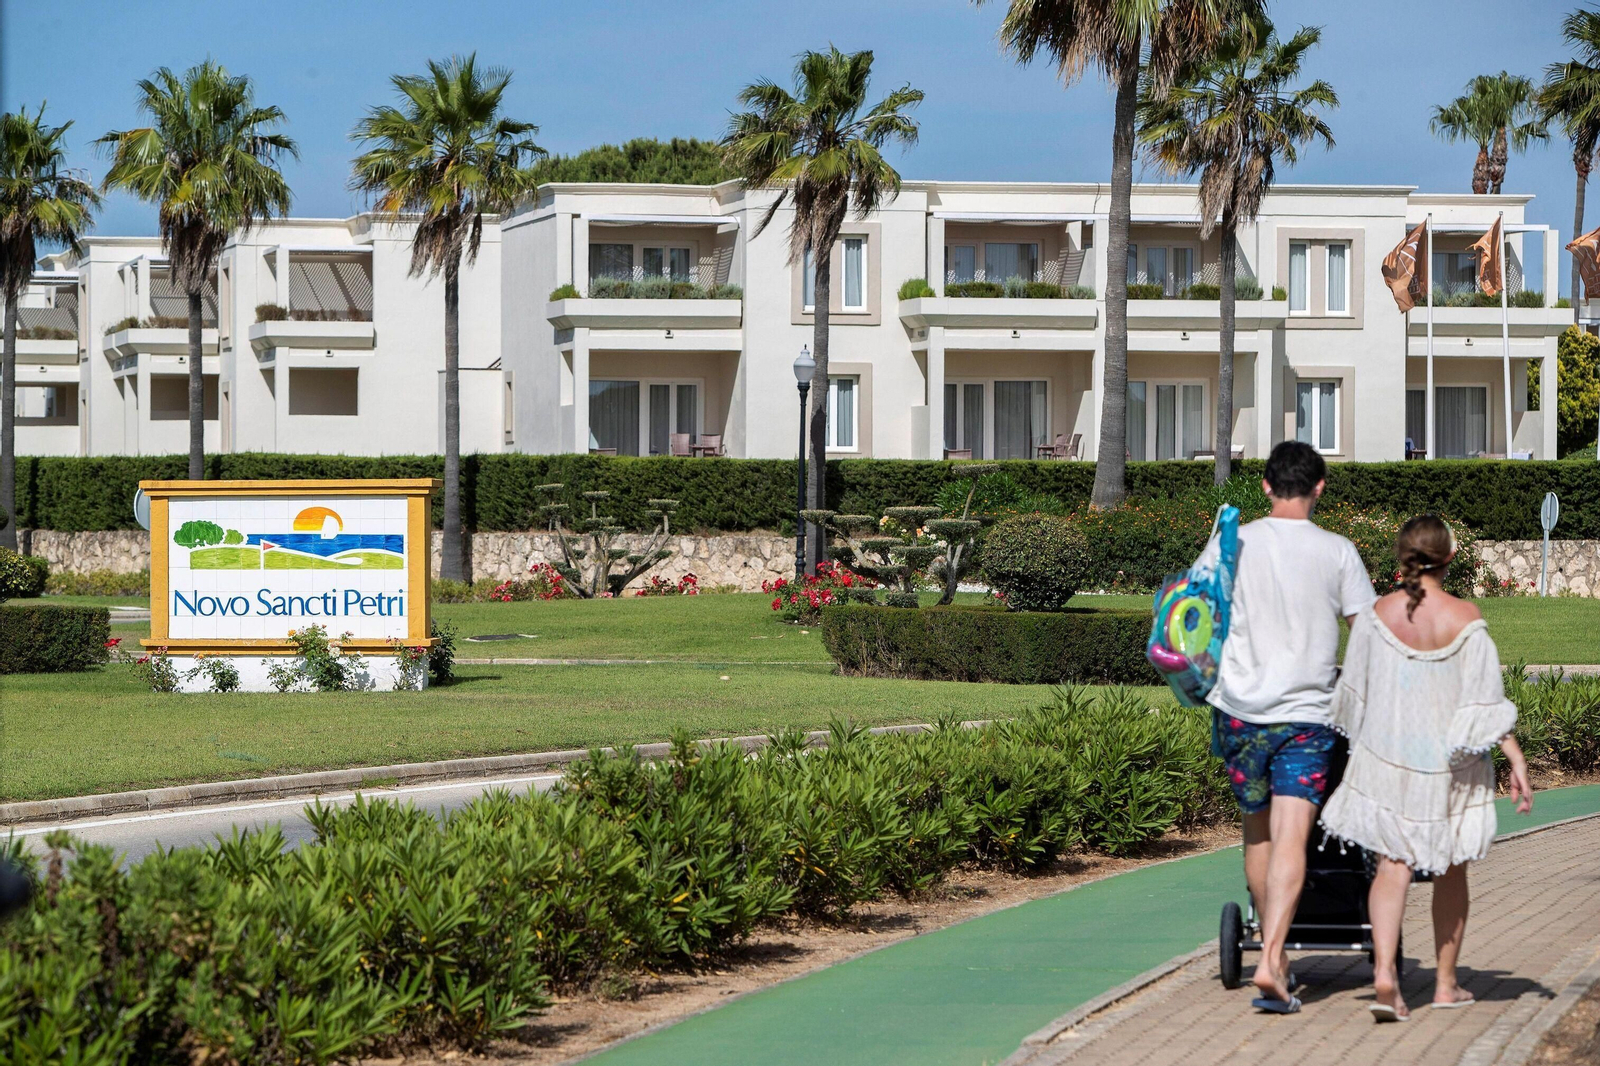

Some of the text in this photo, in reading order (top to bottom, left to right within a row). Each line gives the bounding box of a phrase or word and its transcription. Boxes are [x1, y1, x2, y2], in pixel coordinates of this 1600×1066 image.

[174, 588, 404, 616] Novo Sancti Petri
